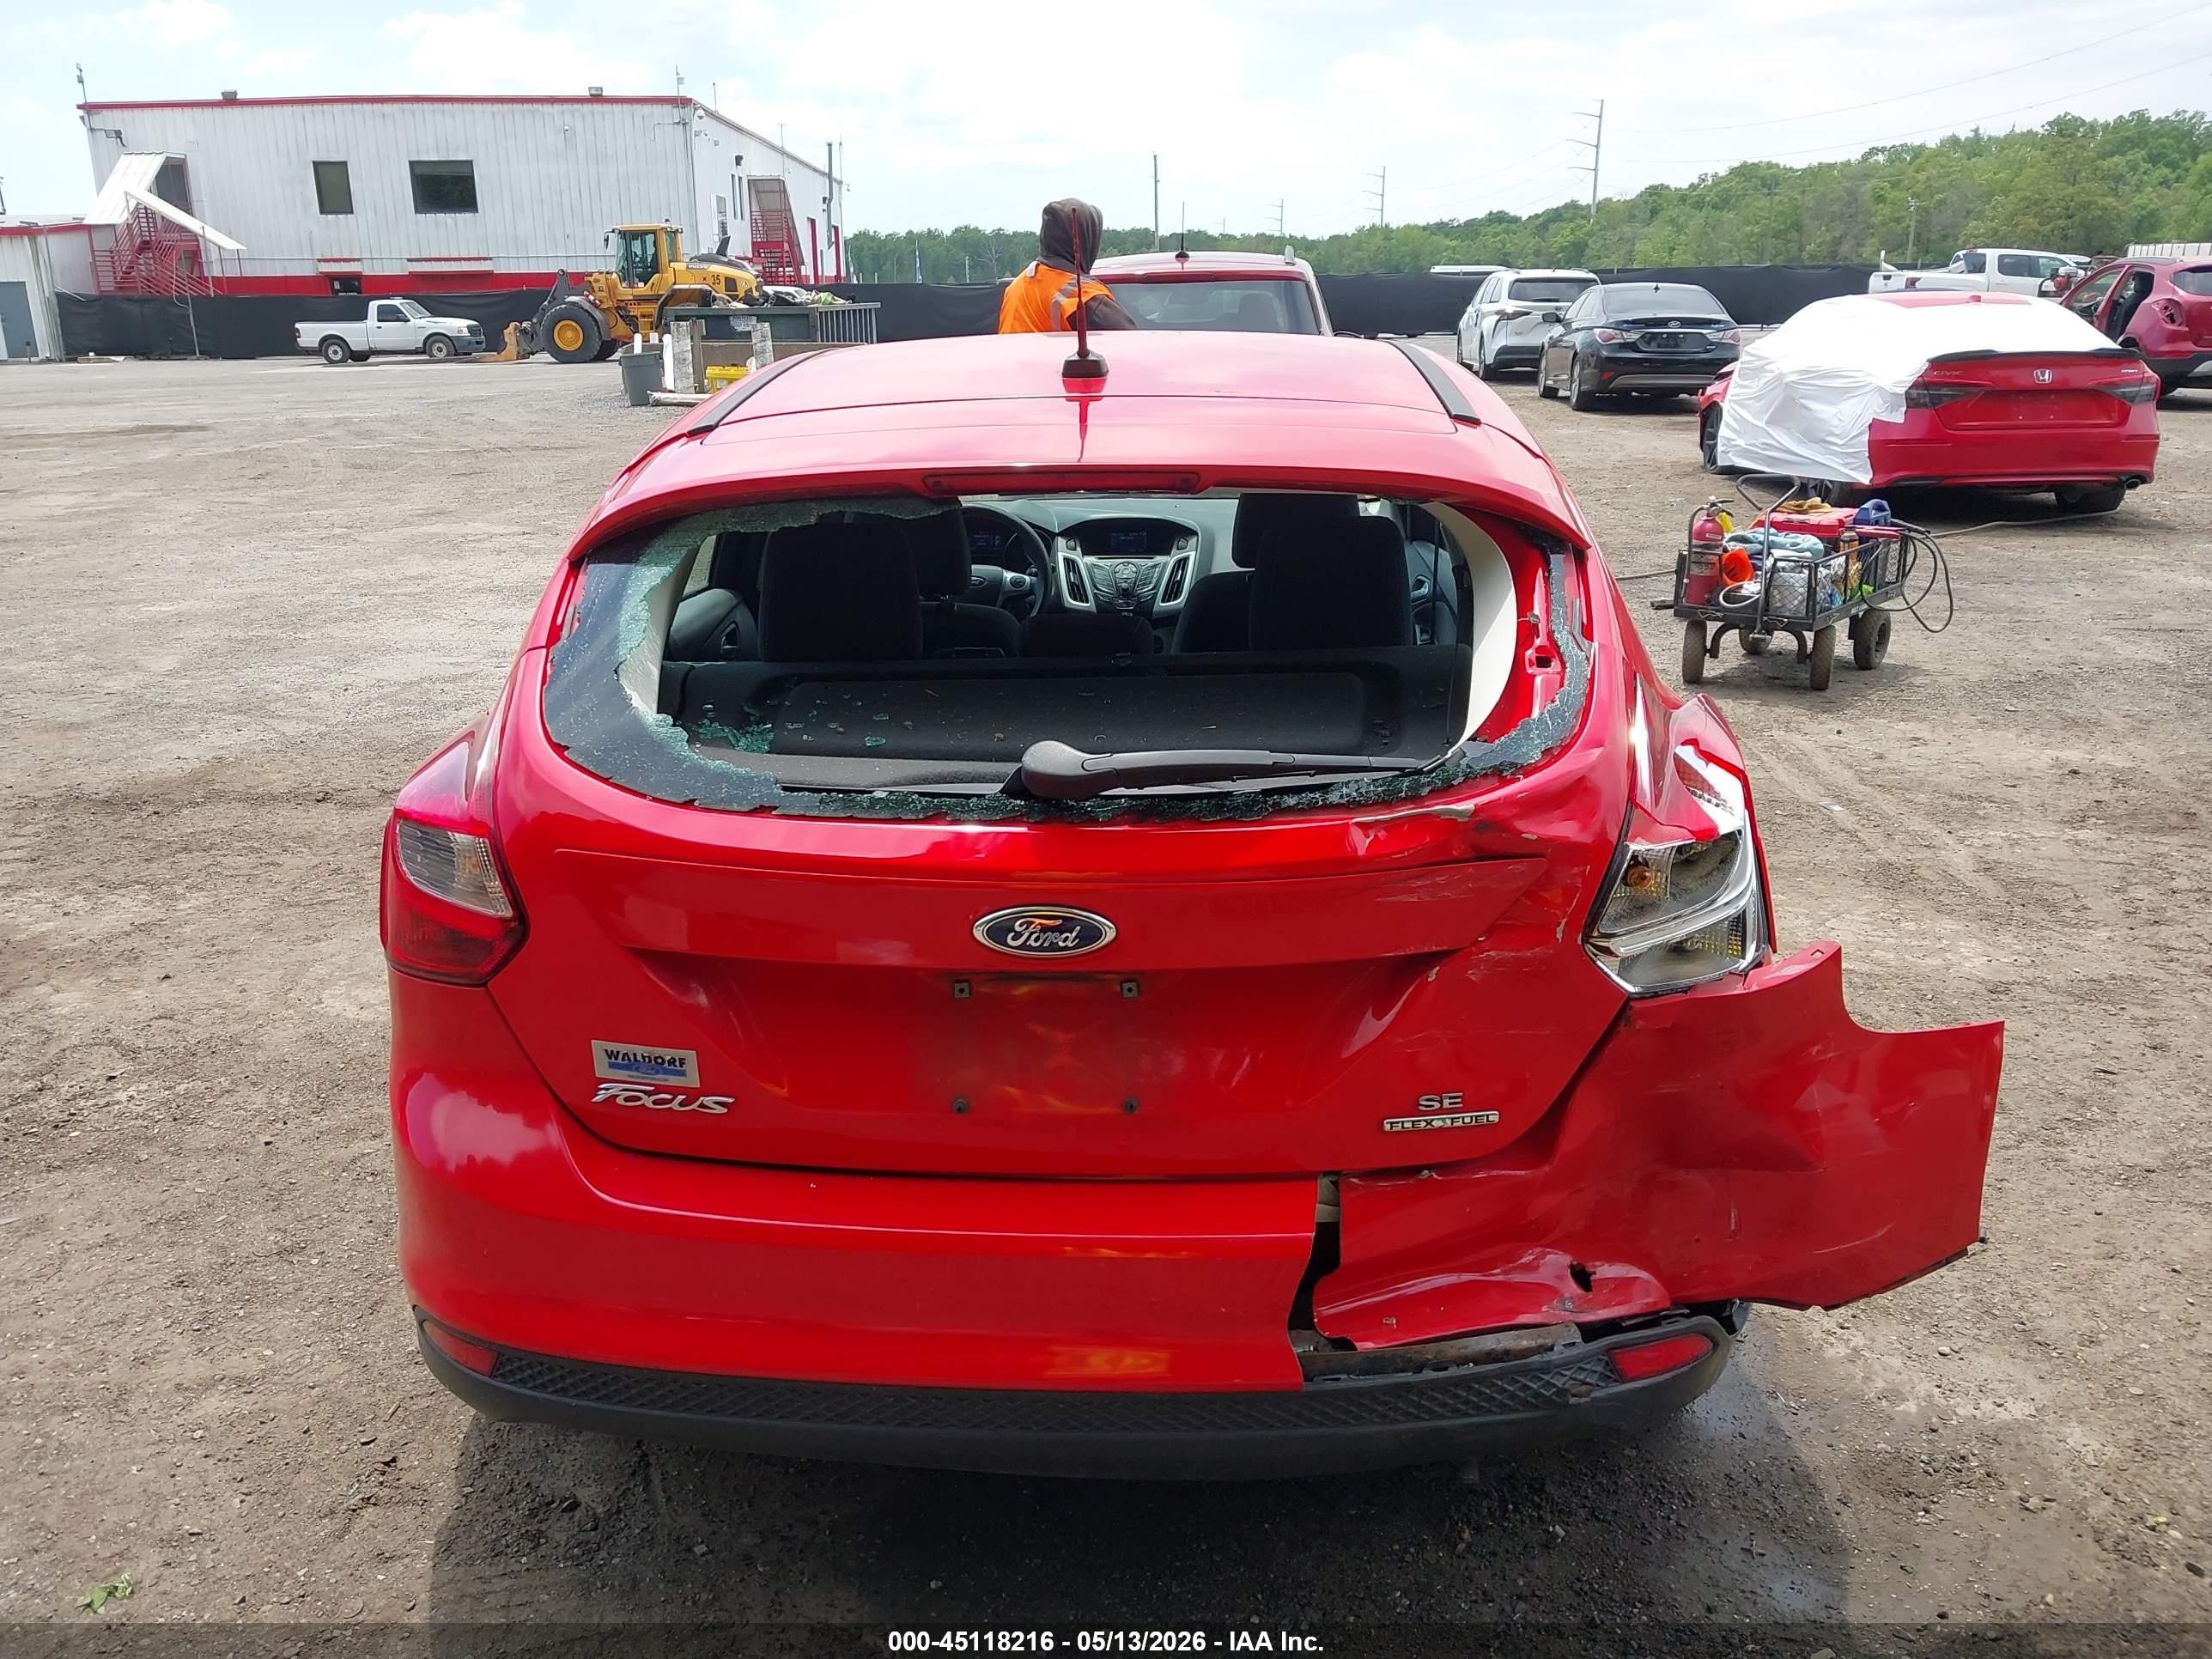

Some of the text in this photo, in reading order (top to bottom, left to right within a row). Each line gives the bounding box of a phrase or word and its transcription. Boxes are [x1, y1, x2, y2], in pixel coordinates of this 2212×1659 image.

[711, 275, 721, 285] 35
[1006, 917, 1081, 947] Ford
[604, 1048, 687, 1069] WALDORF
[1418, 1092, 1463, 1111] SE
[1389, 1114, 1496, 1131] FLEX FUEL
